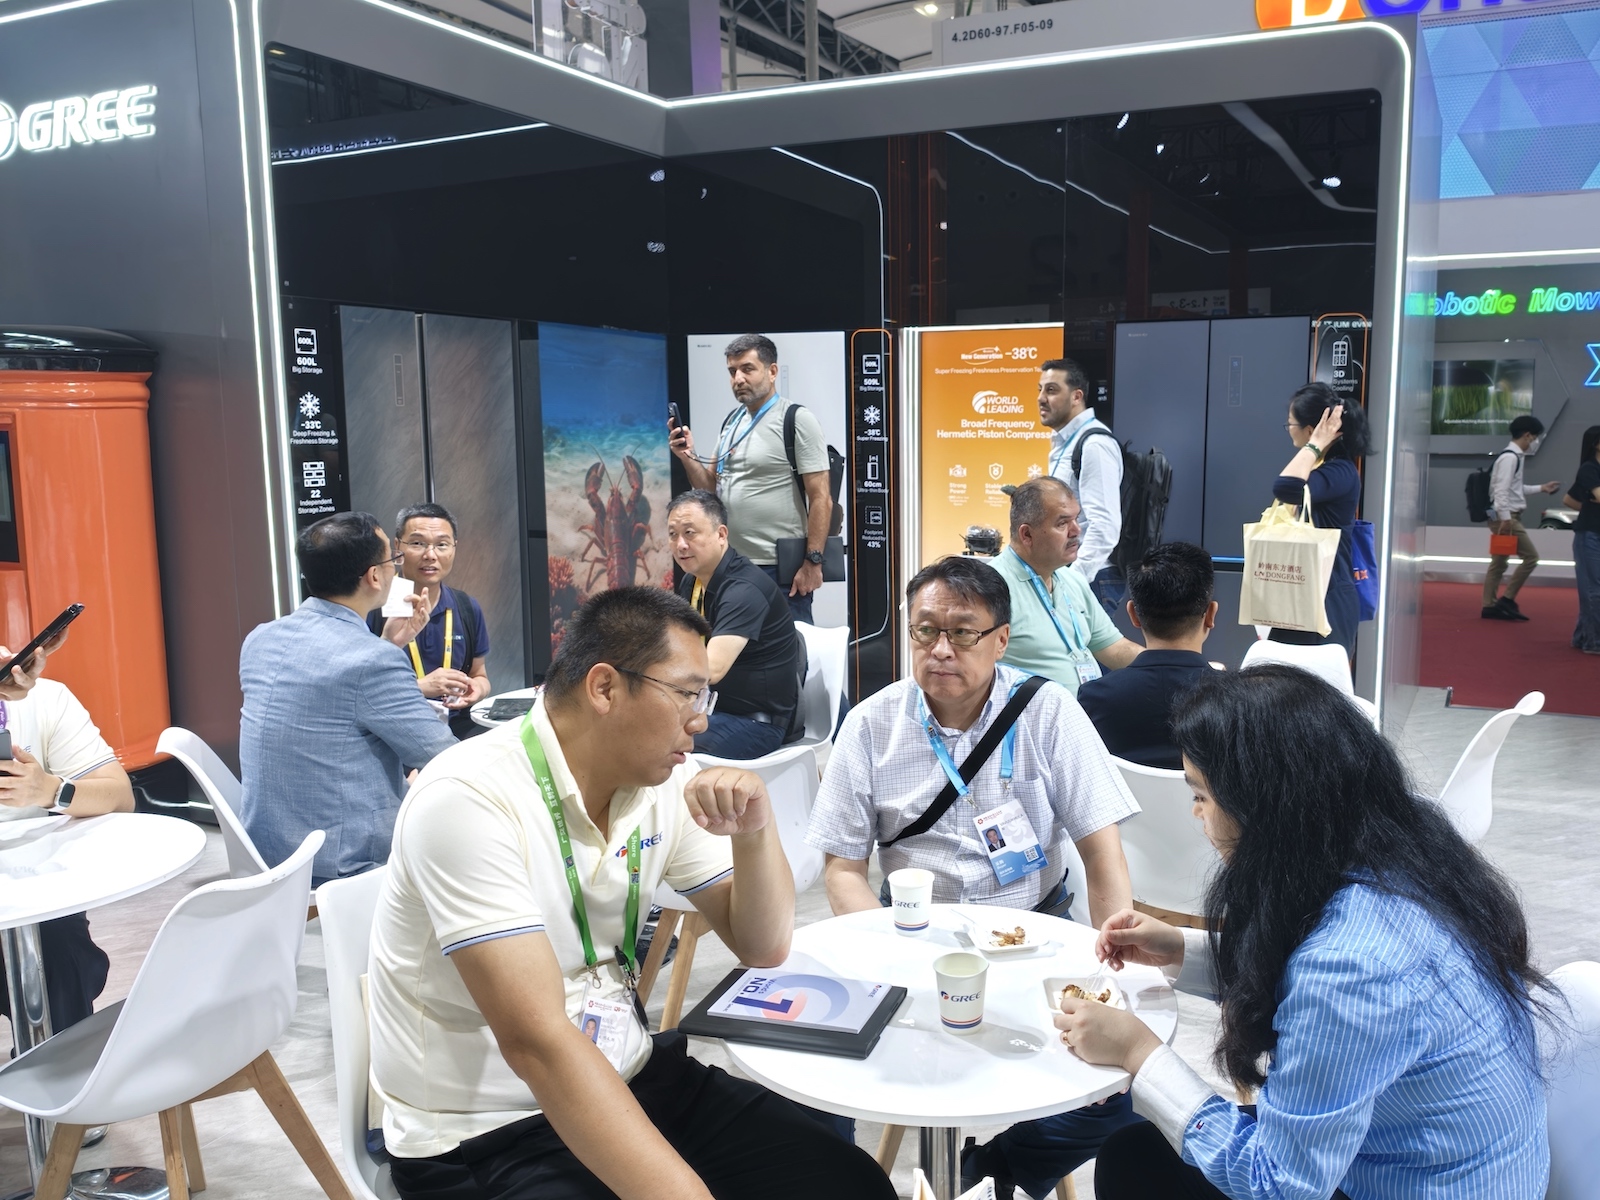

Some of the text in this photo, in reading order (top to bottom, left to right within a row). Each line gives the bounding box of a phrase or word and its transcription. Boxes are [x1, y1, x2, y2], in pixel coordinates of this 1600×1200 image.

[952, 19, 1053, 42] 4.2D60-97.F05-09
[19, 85, 157, 152] GREE
[1528, 287, 1600, 312] Mow
[298, 337, 313, 345] 600L
[296, 357, 317, 366] 600L
[292, 366, 323, 375] Big Storage
[1333, 370, 1345, 378] 3D
[987, 396, 1019, 404] WORLD
[986, 405, 1024, 414] LEADING
[961, 419, 1035, 430] Broad Frequency
[936, 430, 1052, 440] Hermetic Piston Compress
[310, 490, 321, 498] 22
[300, 498, 332, 506] Independent
[1266, 571, 1306, 582] DONGFANG
[894, 900, 920, 908] GREE
[951, 990, 982, 1003] GREE
